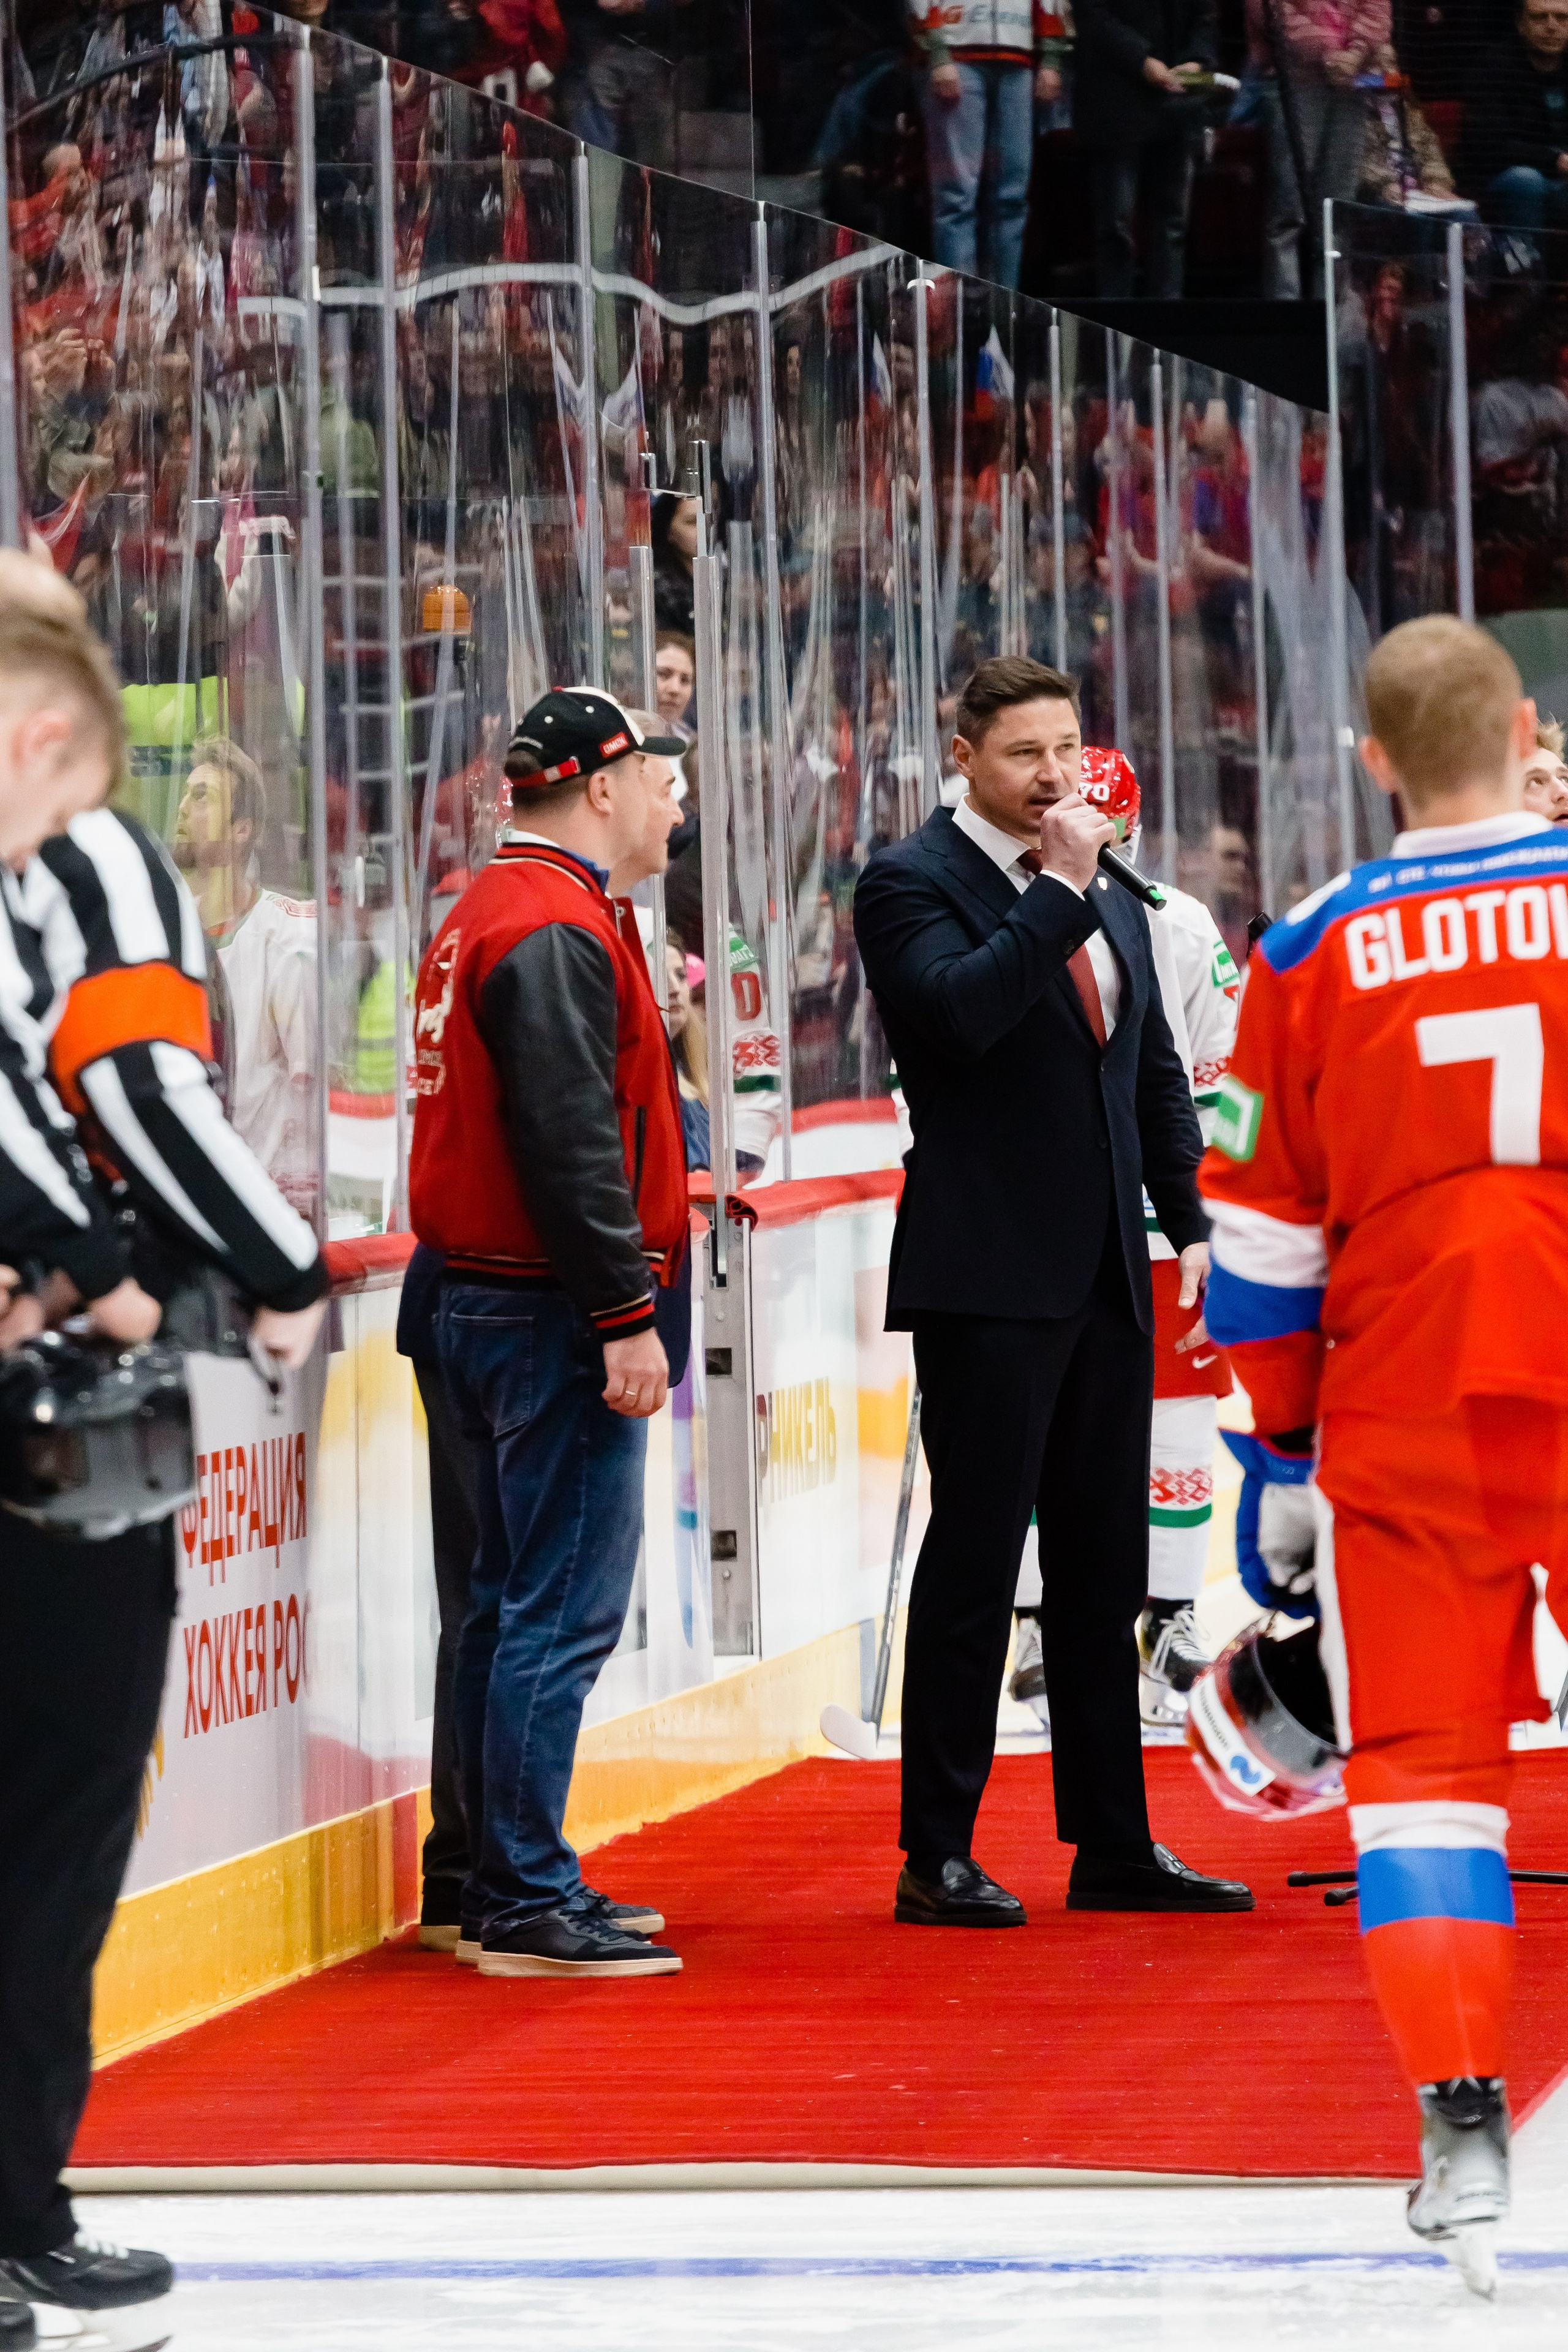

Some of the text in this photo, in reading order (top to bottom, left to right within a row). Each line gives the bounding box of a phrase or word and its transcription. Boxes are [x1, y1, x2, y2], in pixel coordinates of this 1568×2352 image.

[1079, 782, 1110, 802] 70
[1414, 1001, 1544, 1166] 7
[183, 1604, 267, 1739] ХОККЕЯ
